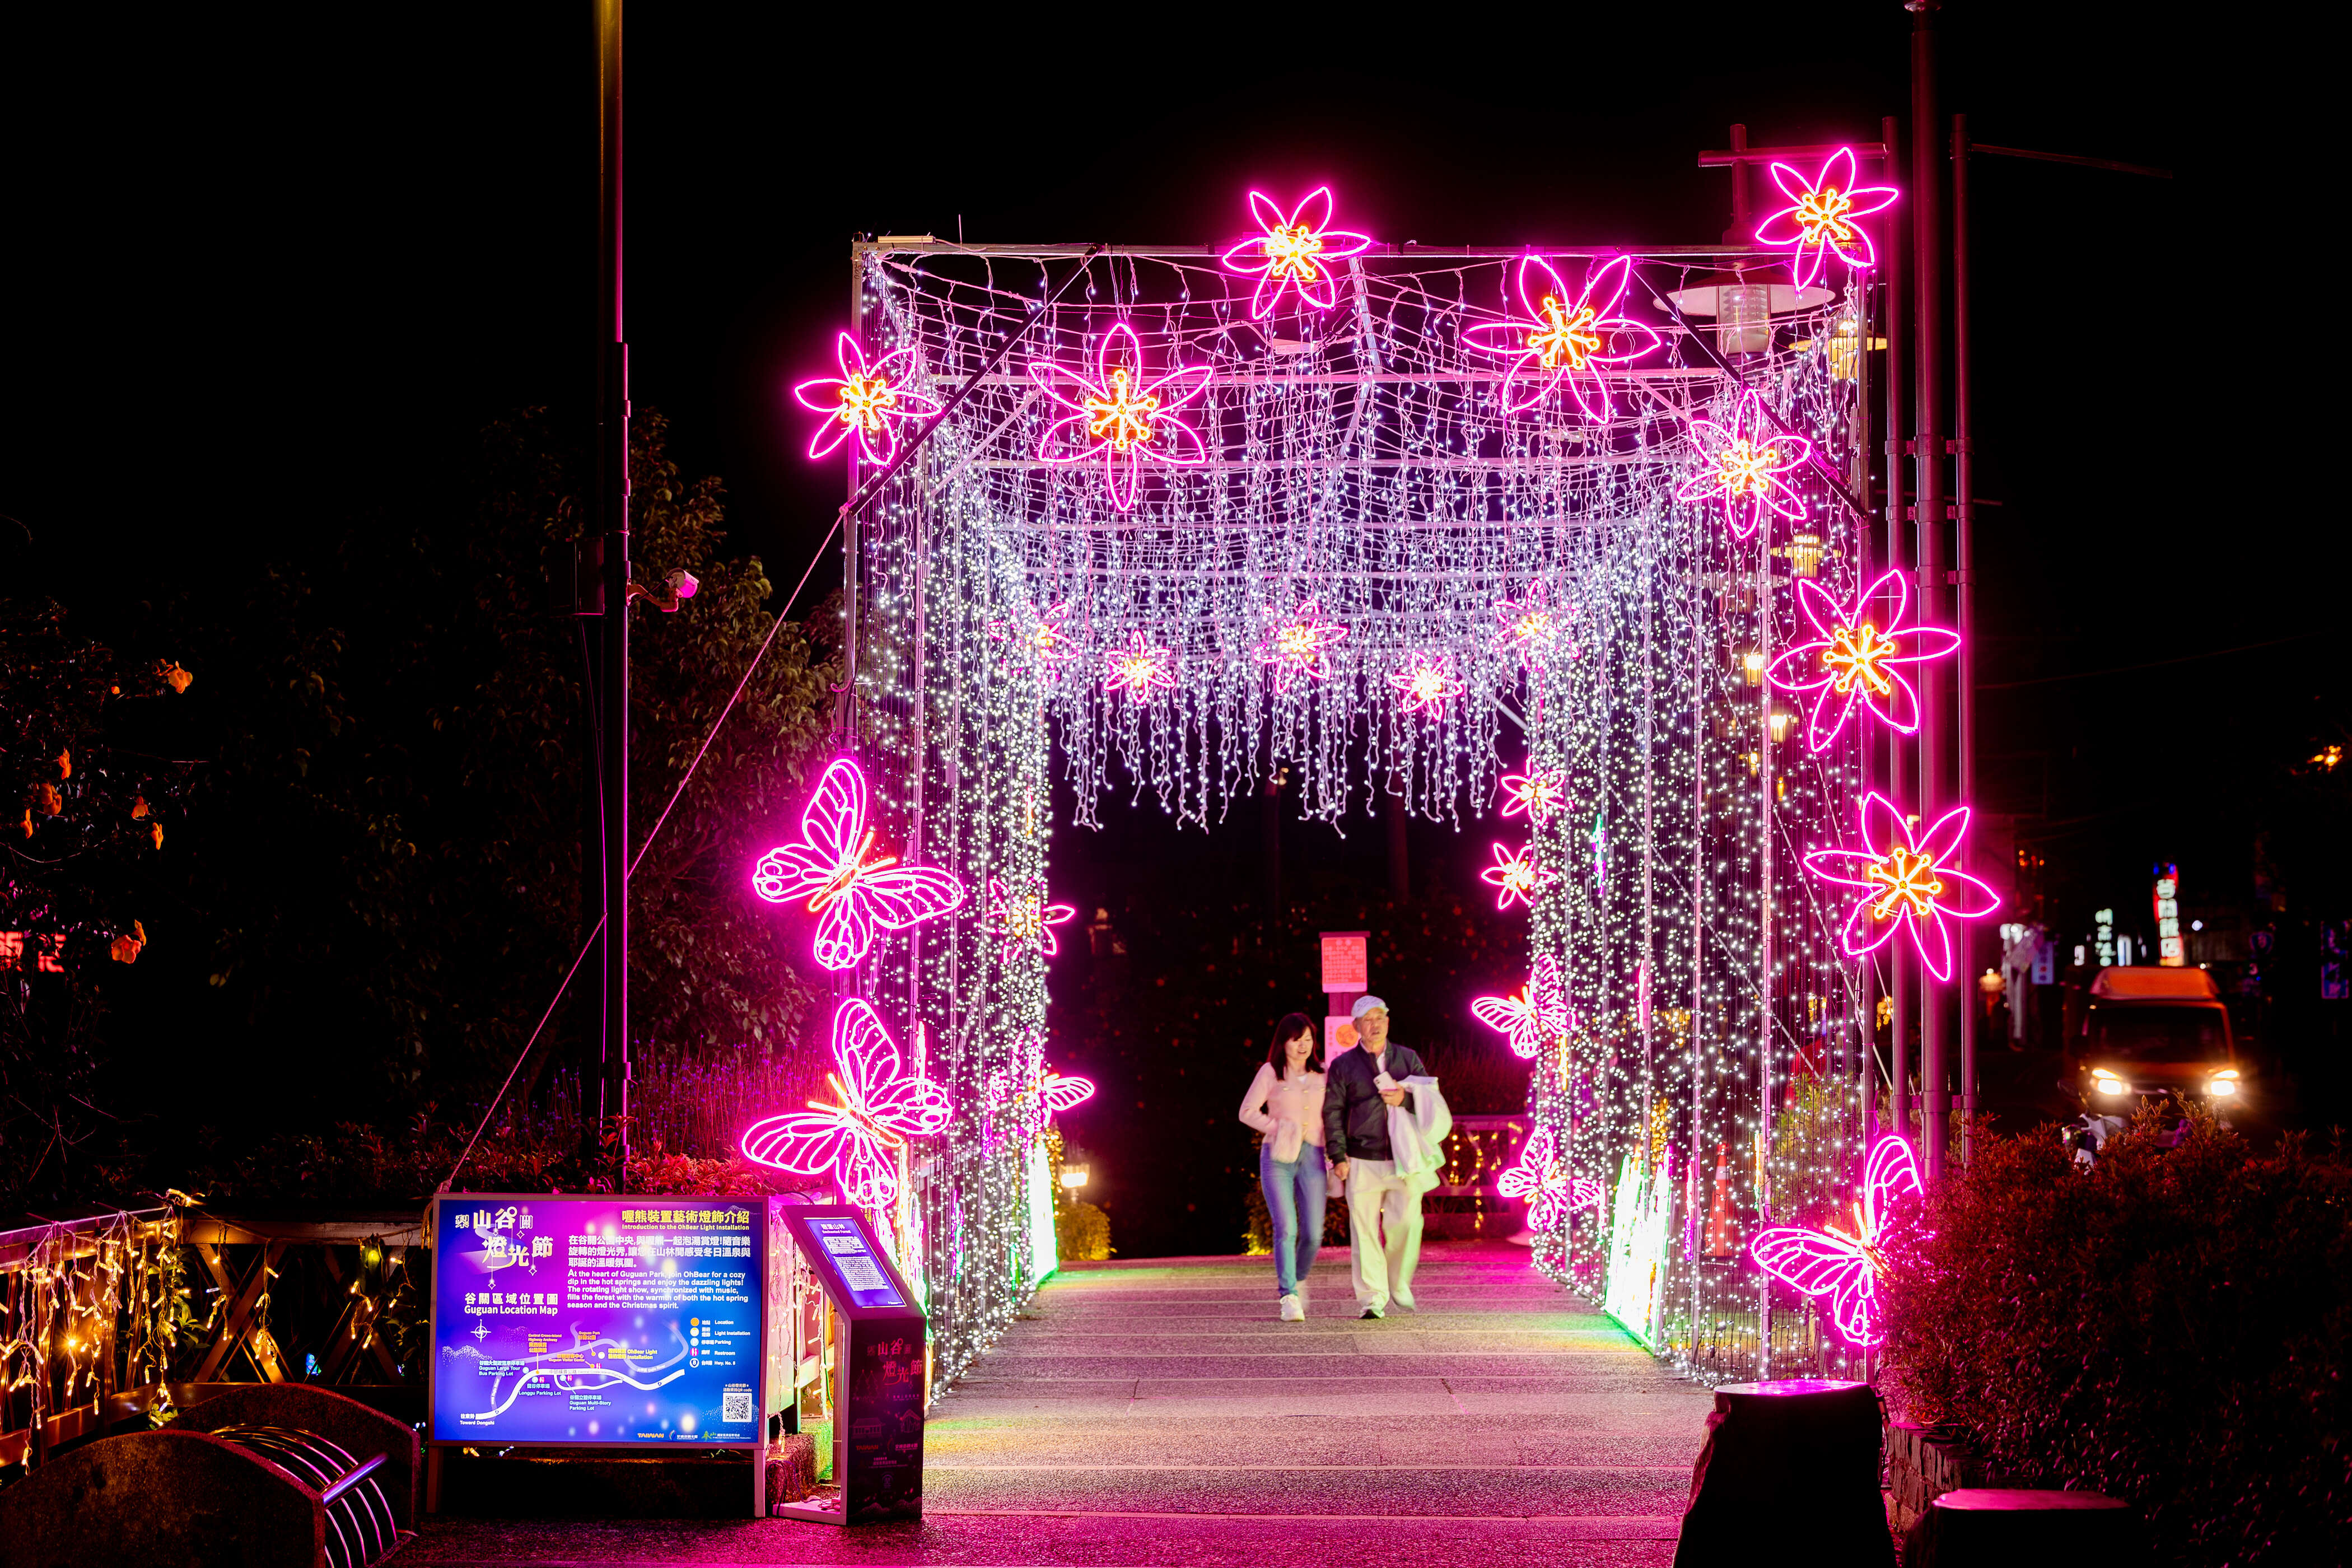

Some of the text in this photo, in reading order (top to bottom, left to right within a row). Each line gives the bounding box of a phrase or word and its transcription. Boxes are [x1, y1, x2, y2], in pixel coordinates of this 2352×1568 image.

[622, 1210, 749, 1223] 喔熊裝置藝術燈飾介紹
[482, 1236, 553, 1268] 燈光節
[465, 1292, 558, 1305] 谷關區域位置圖
[464, 1305, 558, 1316] Guguan Location Map
